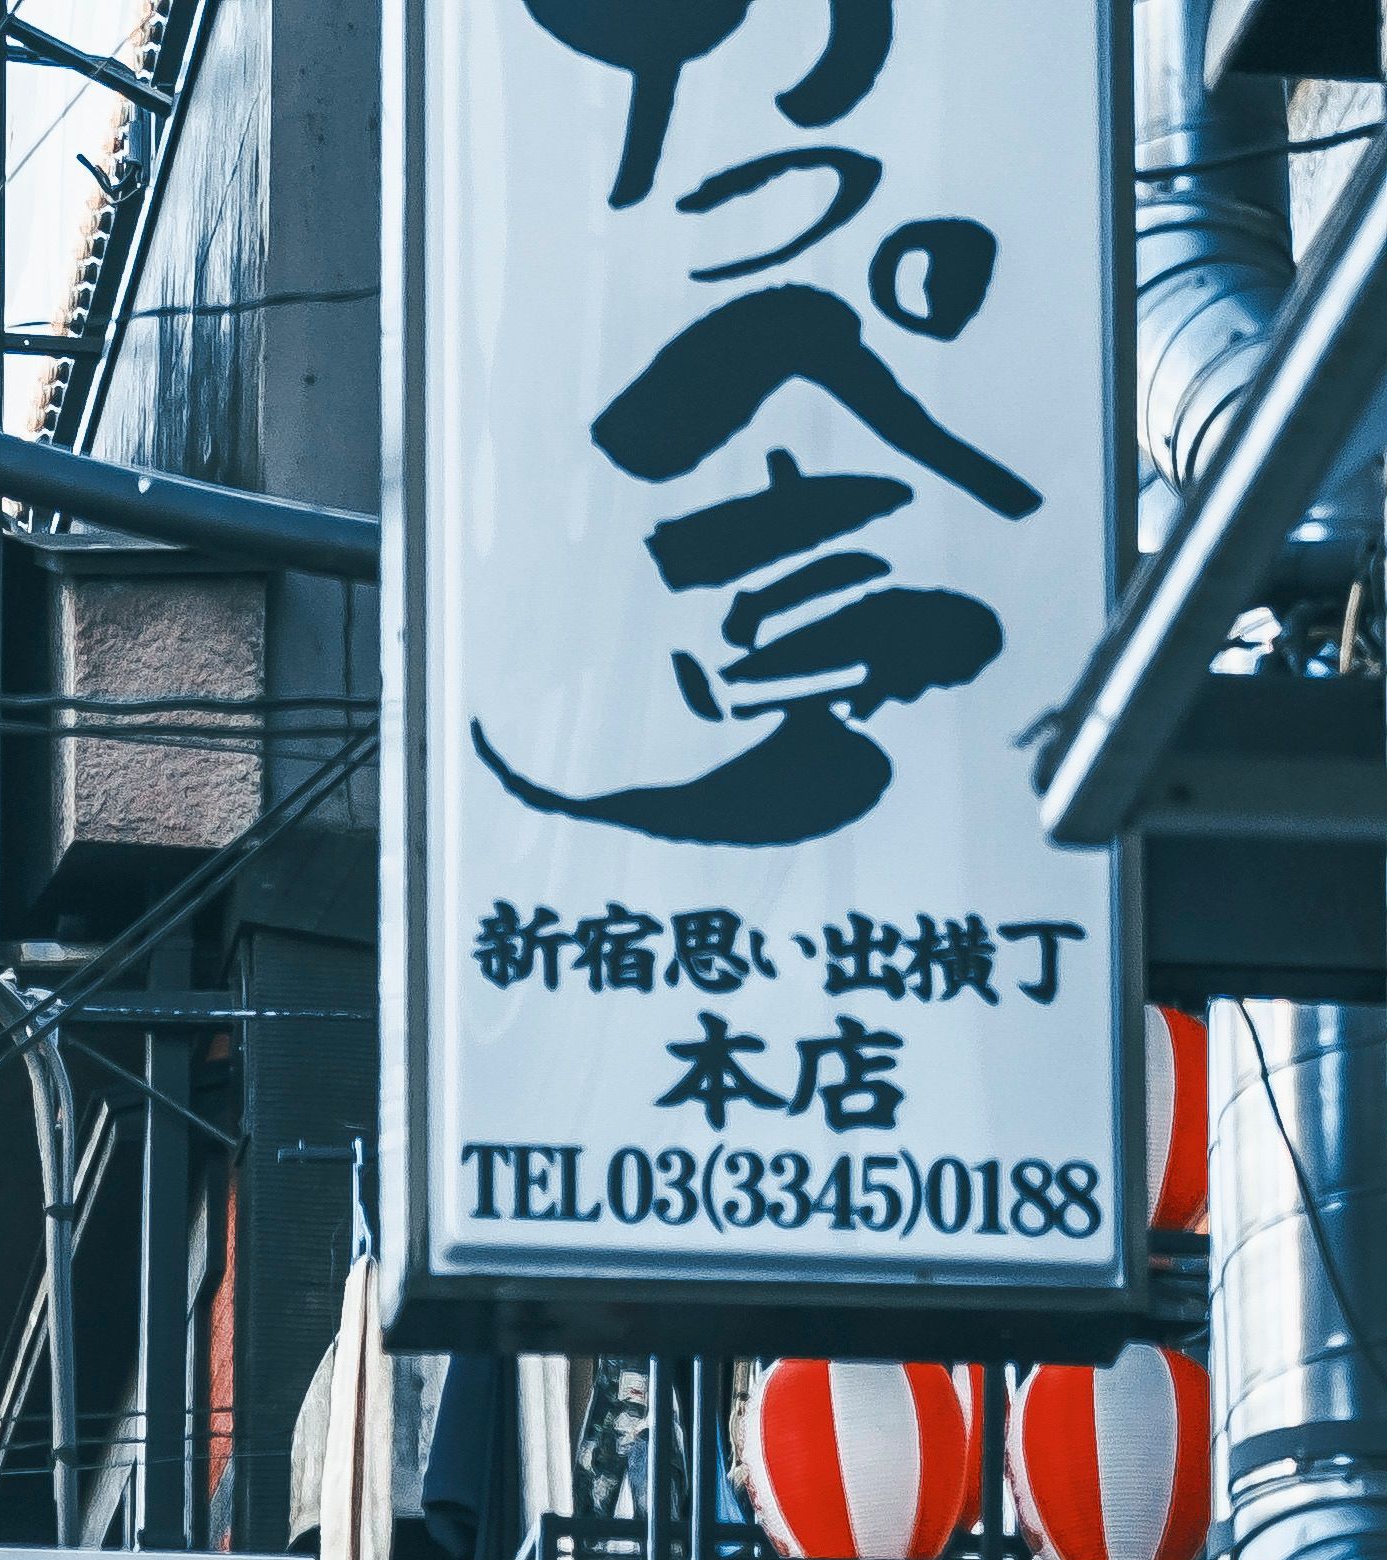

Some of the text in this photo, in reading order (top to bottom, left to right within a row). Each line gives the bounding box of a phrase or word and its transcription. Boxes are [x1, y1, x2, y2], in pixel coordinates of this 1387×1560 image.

[472, 899, 1088, 1008] 新宿思い出横丁
[654, 1008, 908, 1131] 本店
